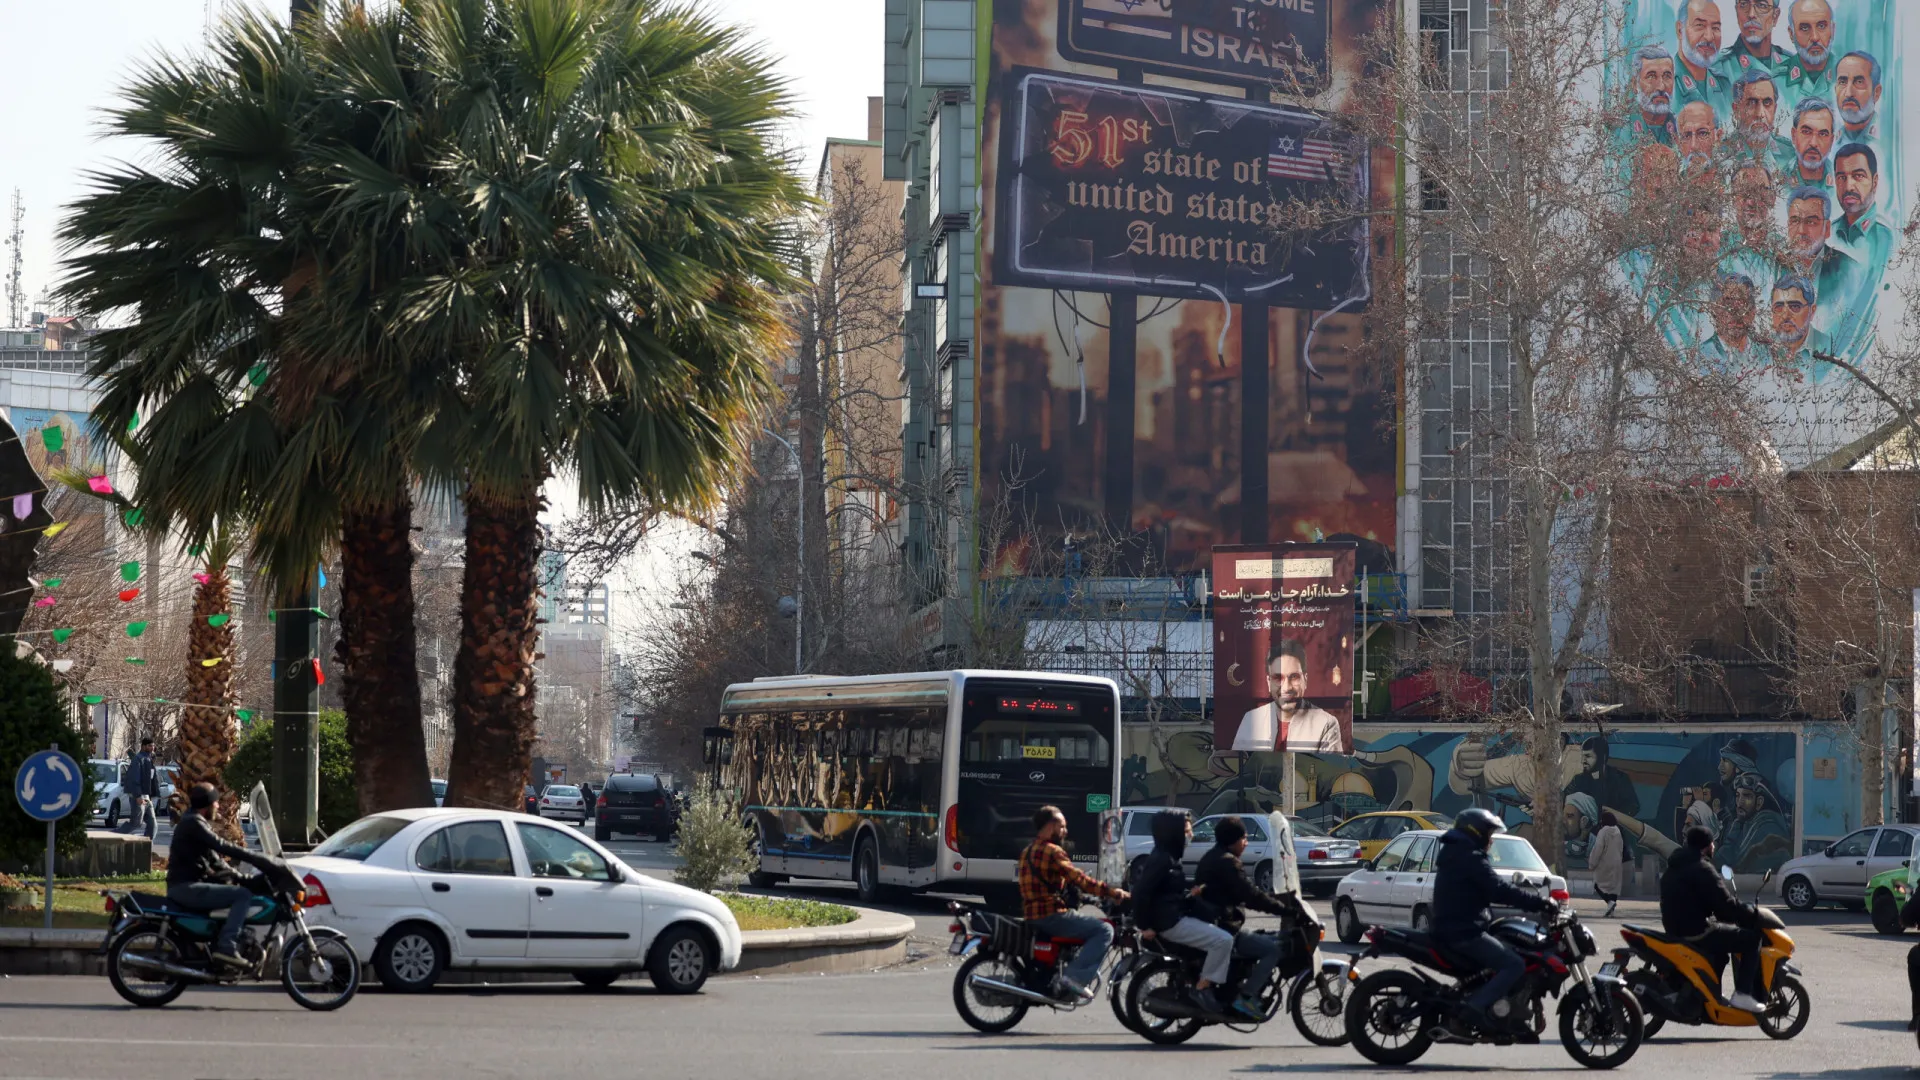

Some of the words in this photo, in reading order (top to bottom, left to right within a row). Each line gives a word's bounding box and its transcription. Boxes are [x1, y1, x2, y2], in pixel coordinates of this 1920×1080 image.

[1143, 147, 1220, 182] state
[1233, 156, 1262, 186] of
[1067, 177, 1174, 216] united
[1185, 190, 1283, 229] states
[1126, 219, 1268, 266] America
[1219, 587, 1243, 600] است
[1243, 590, 1270, 603] من
[1270, 587, 1299, 603] جان
[1299, 583, 1318, 604] آرام
[1025, 747, 1053, 757] ۳۵۸۶۵
